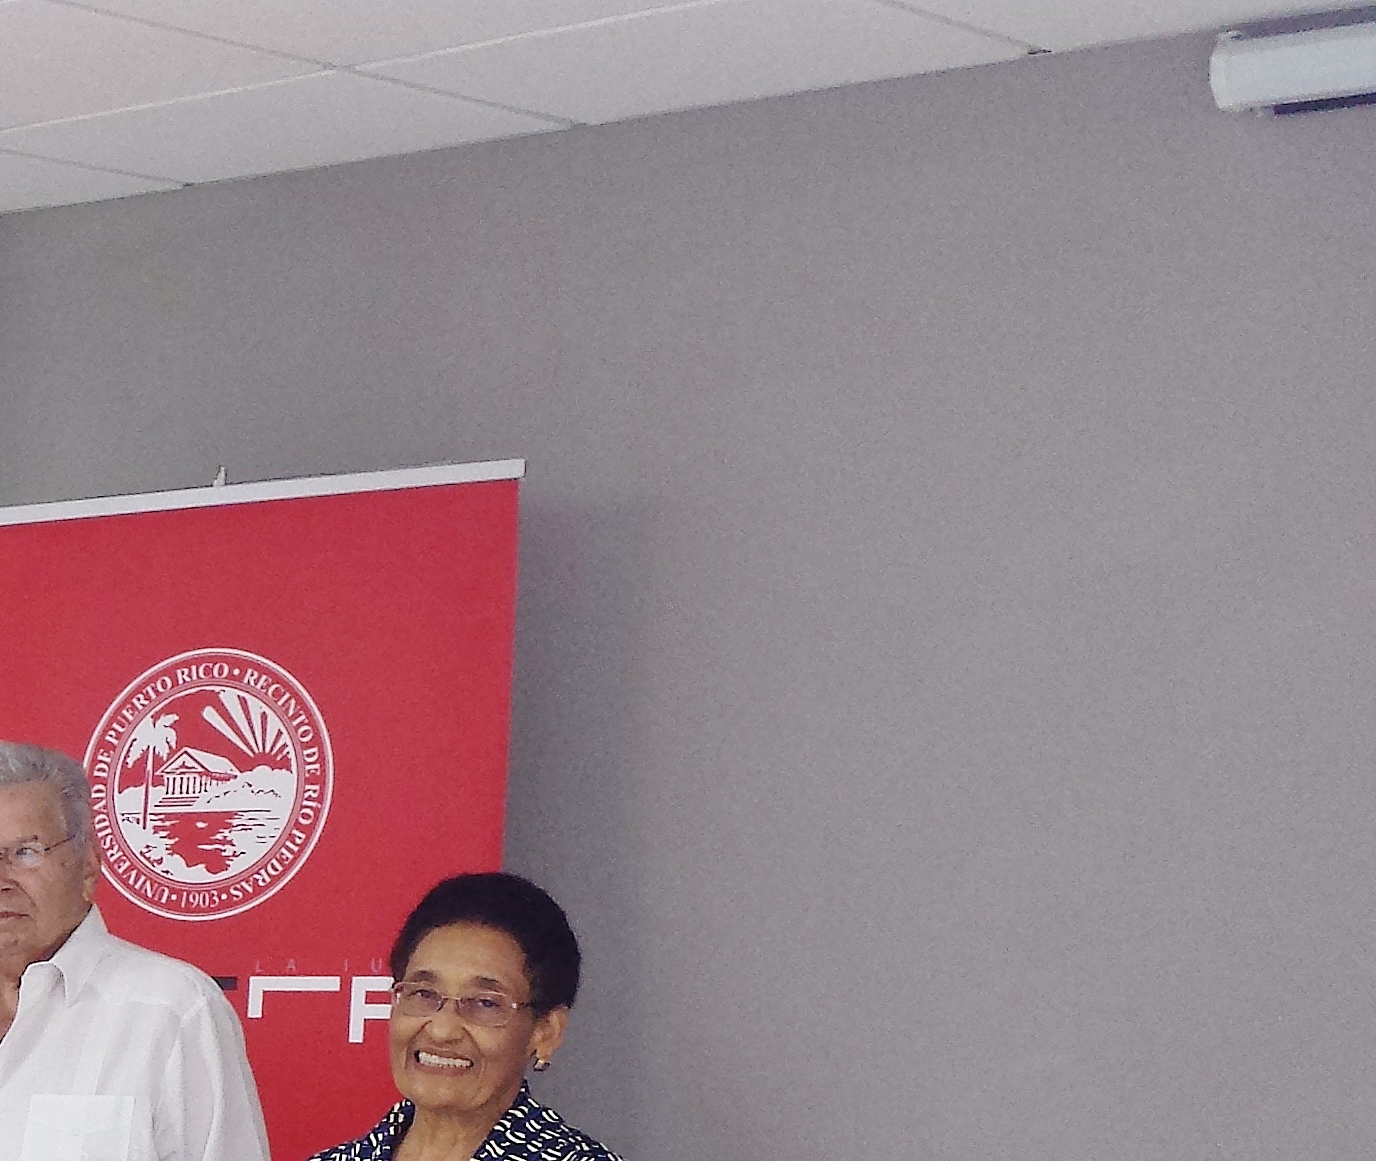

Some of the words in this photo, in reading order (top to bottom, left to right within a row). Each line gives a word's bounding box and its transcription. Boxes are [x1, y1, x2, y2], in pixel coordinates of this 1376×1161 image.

[176, 662, 230, 685] RICO
[104, 676, 173, 745] PUERTO
[243, 668, 314, 743] RECINTO
[93, 748, 115, 778] DE
[303, 746, 321, 777] DE
[297, 784, 322, 825] RÍO
[90, 783, 170, 904] UNIVERSIDAD
[229, 829, 307, 901] PIEDRAS
[180, 890, 220, 908] 1903
